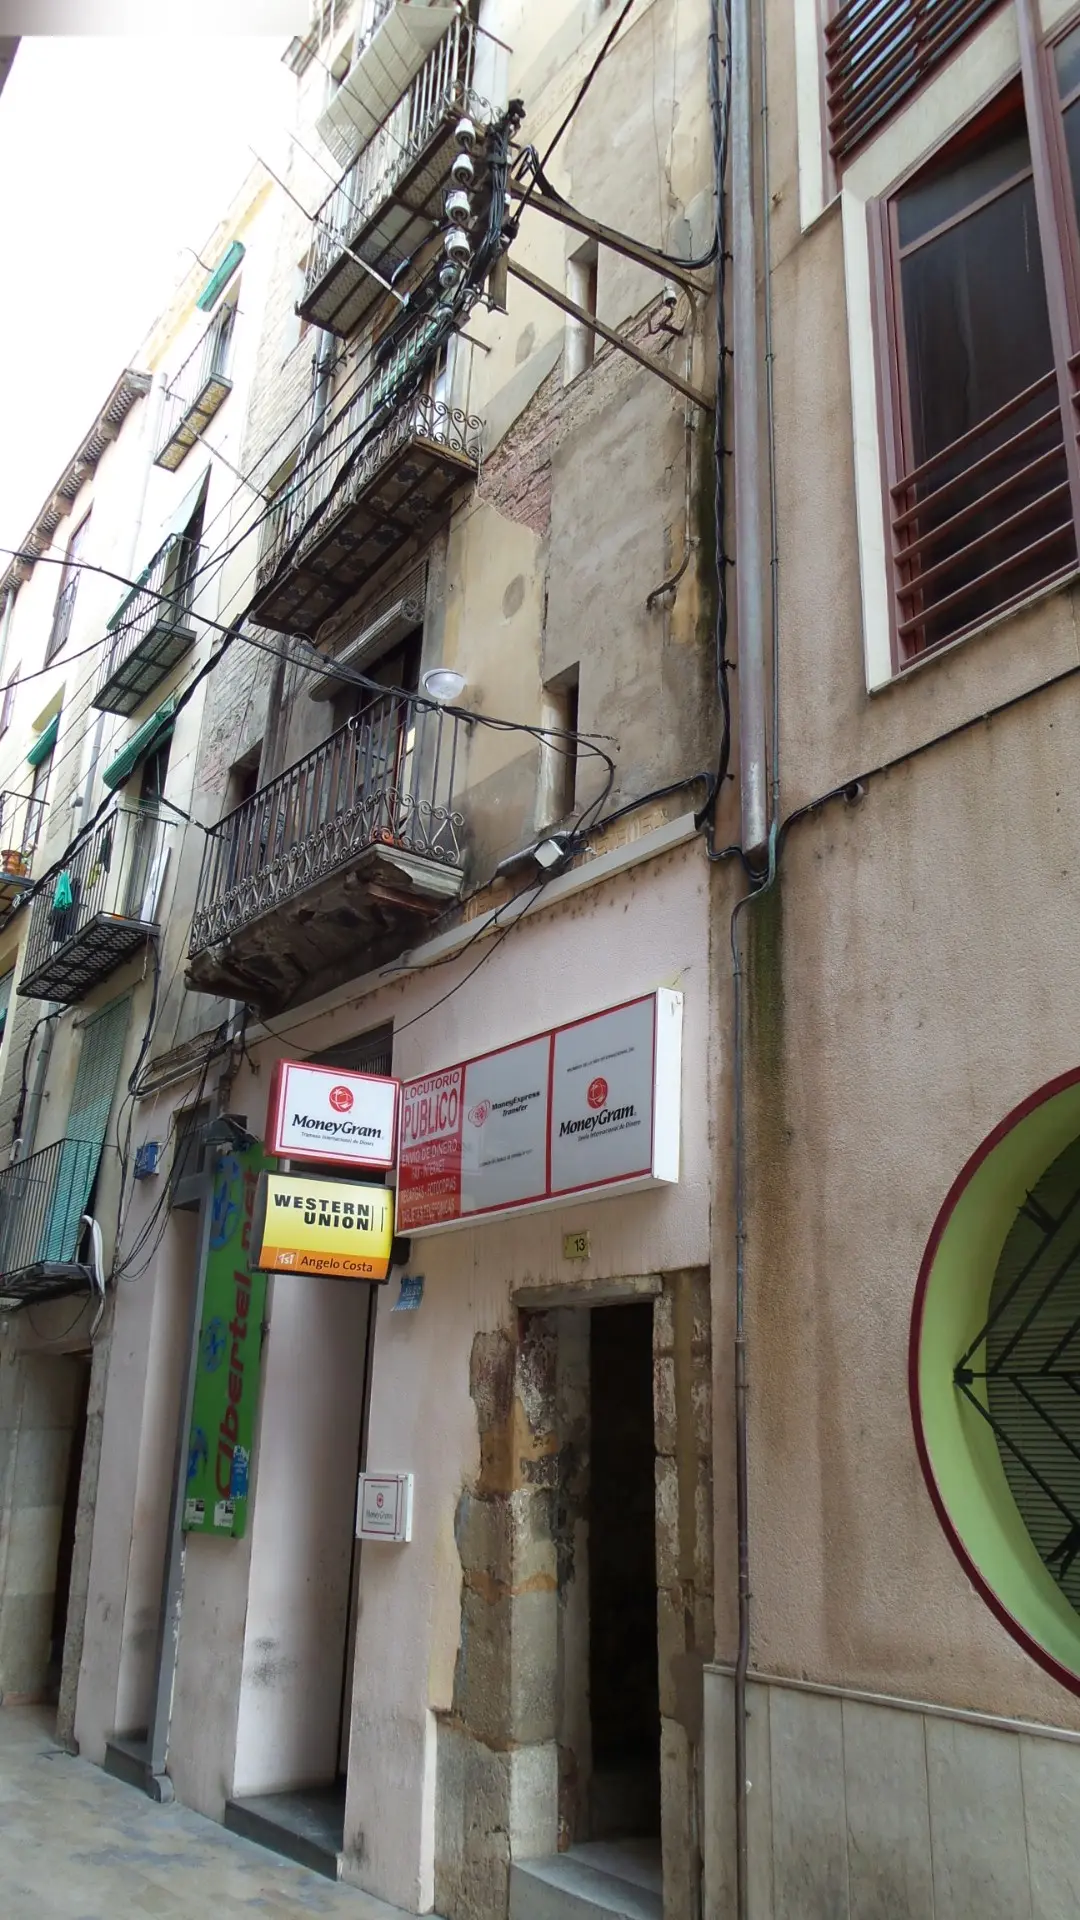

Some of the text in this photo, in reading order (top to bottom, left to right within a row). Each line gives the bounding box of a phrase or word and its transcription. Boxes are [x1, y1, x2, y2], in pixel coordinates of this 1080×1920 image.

[404, 1071, 460, 1101] LOCUTORIO
[492, 1091, 540, 1111] MoneyExpress
[503, 1104, 528, 1117] Transfer
[292, 1114, 382, 1138] MoneyGram
[402, 1087, 458, 1143] PUBLICO
[559, 1104, 634, 1137] MoneyGram
[274, 1193, 369, 1217] WESTERN
[304, 1211, 369, 1231] UNION
[574, 1238, 586, 1252] 13
[301, 1255, 340, 1270] Angelo
[343, 1260, 373, 1272] Costa
